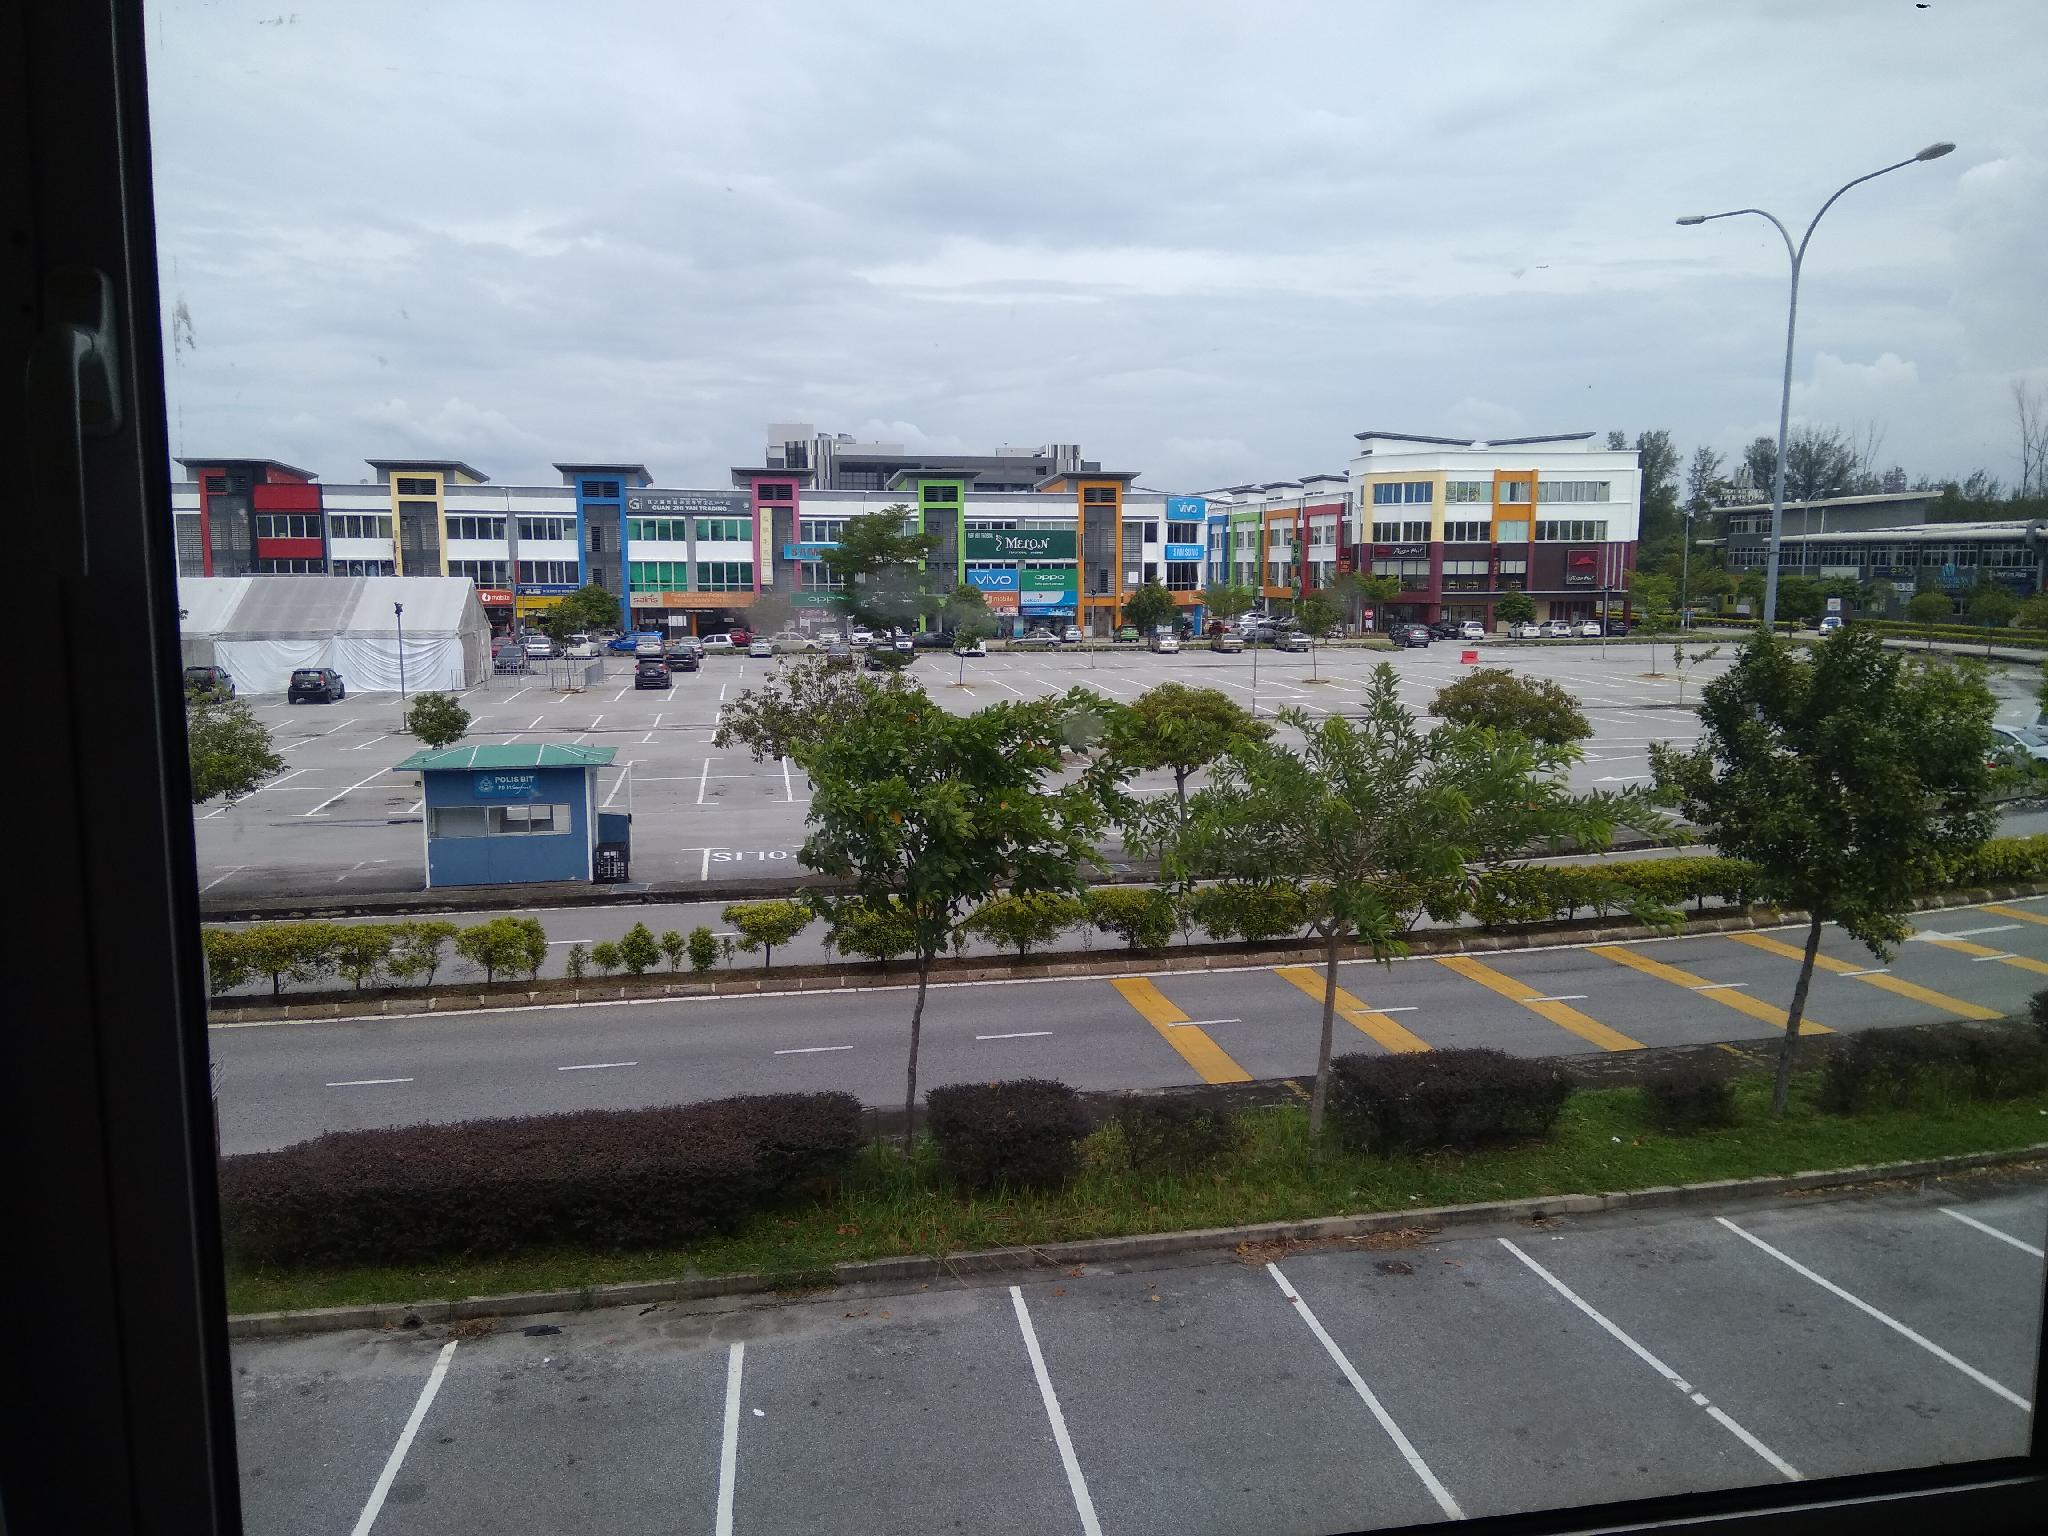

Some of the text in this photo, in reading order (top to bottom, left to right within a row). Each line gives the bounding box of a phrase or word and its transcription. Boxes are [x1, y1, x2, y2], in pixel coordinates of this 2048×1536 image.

[975, 573, 1012, 585] vivo
[495, 775, 535, 784] POLIS BIT
[711, 850, 797, 862] OLIS
